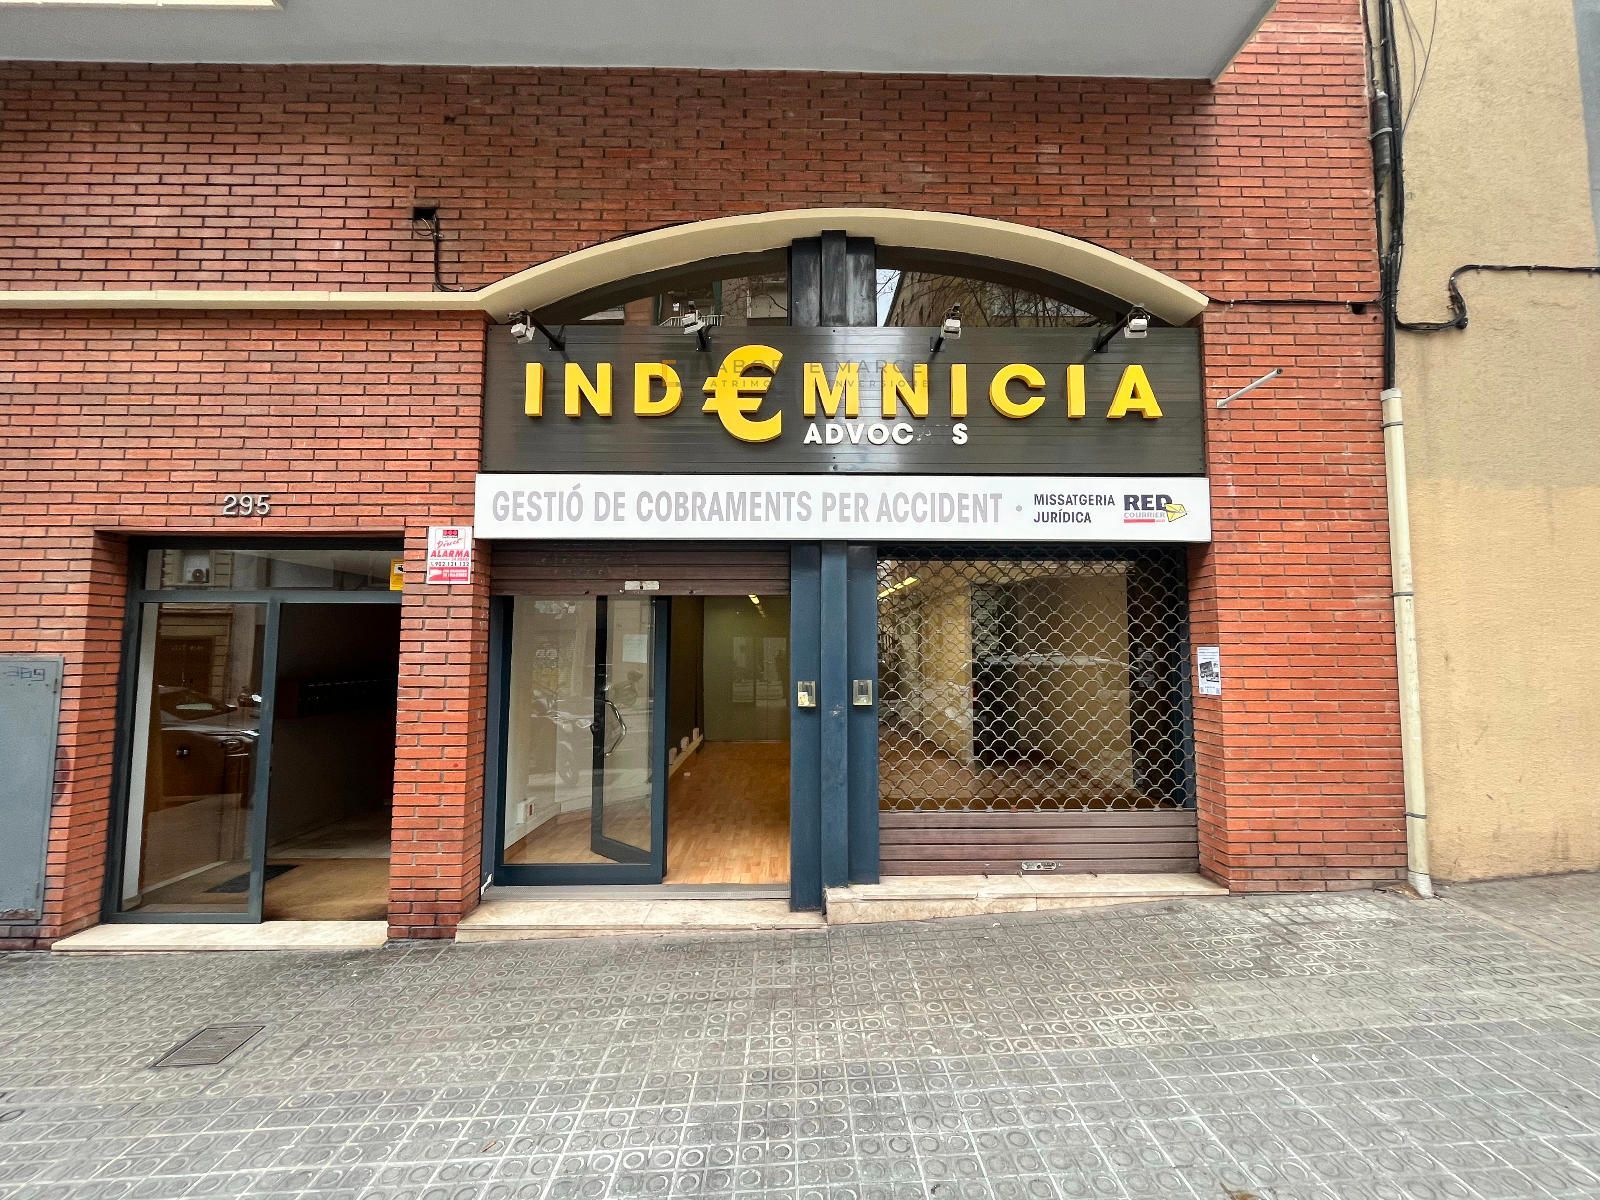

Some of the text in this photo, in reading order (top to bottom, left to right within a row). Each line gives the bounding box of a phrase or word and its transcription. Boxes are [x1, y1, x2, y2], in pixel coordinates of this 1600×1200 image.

[223, 494, 272, 516] 295
[492, 482, 1003, 523] GESTIÓ DE COBRAMENTS PER ACCIDENT
[1033, 493, 1116, 507] MISSATGERIA
[1123, 494, 1173, 511] RED
[1033, 508, 1092, 523] JURÍDICA
[430, 549, 470, 558] ALARMA
